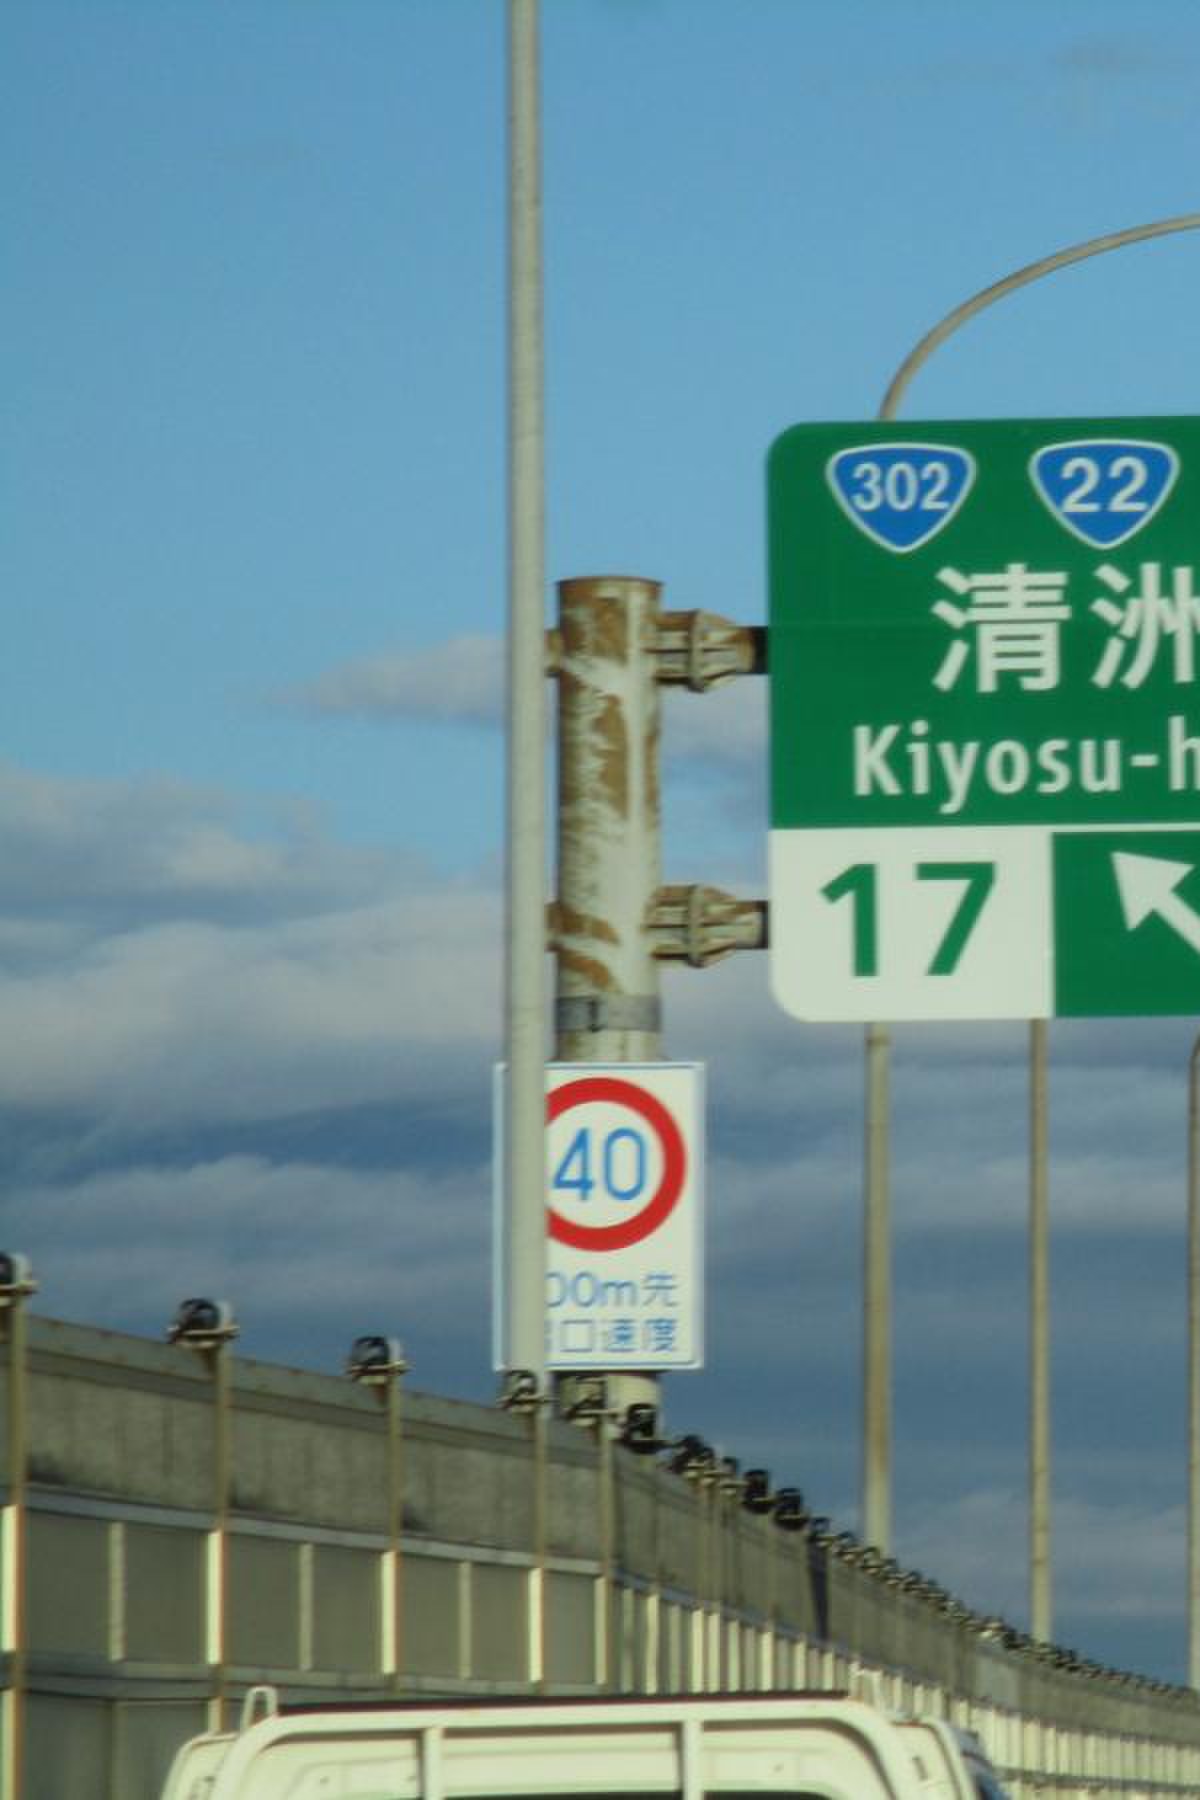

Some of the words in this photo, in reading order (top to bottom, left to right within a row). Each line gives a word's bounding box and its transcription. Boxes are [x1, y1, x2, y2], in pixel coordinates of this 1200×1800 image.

[851, 461, 950, 511] 302
[1060, 456, 1149, 513] 22
[818, 860, 997, 979] 17
[553, 1127, 647, 1201] 40
[544, 1318, 679, 1353] 口速度
